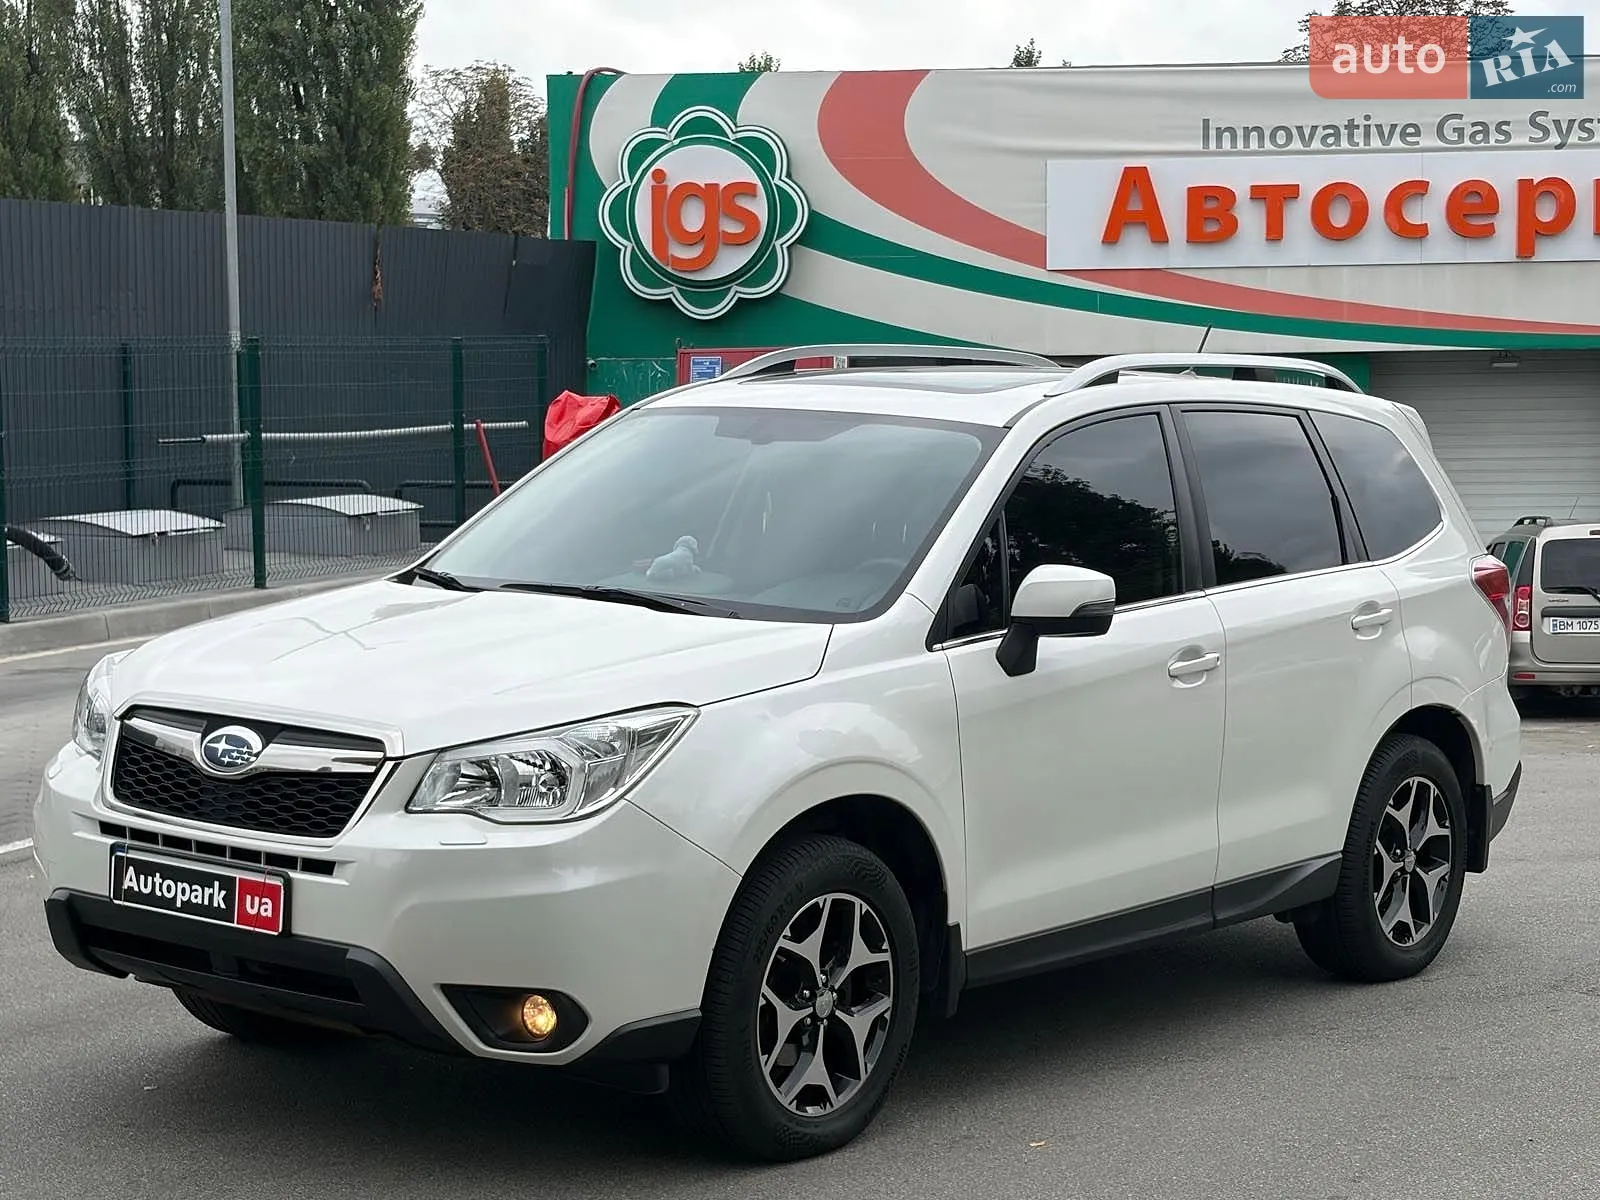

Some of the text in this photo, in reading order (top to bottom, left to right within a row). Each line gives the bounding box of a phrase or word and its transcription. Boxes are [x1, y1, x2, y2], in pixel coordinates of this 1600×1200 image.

[1201, 110, 1600, 151] Innovative Gas Sys
[651, 168, 761, 272] igs
[1101, 165, 1600, 259] Автосер
[1558, 620, 1599, 631] BM 1075
[123, 866, 273, 918] Autopark ua
